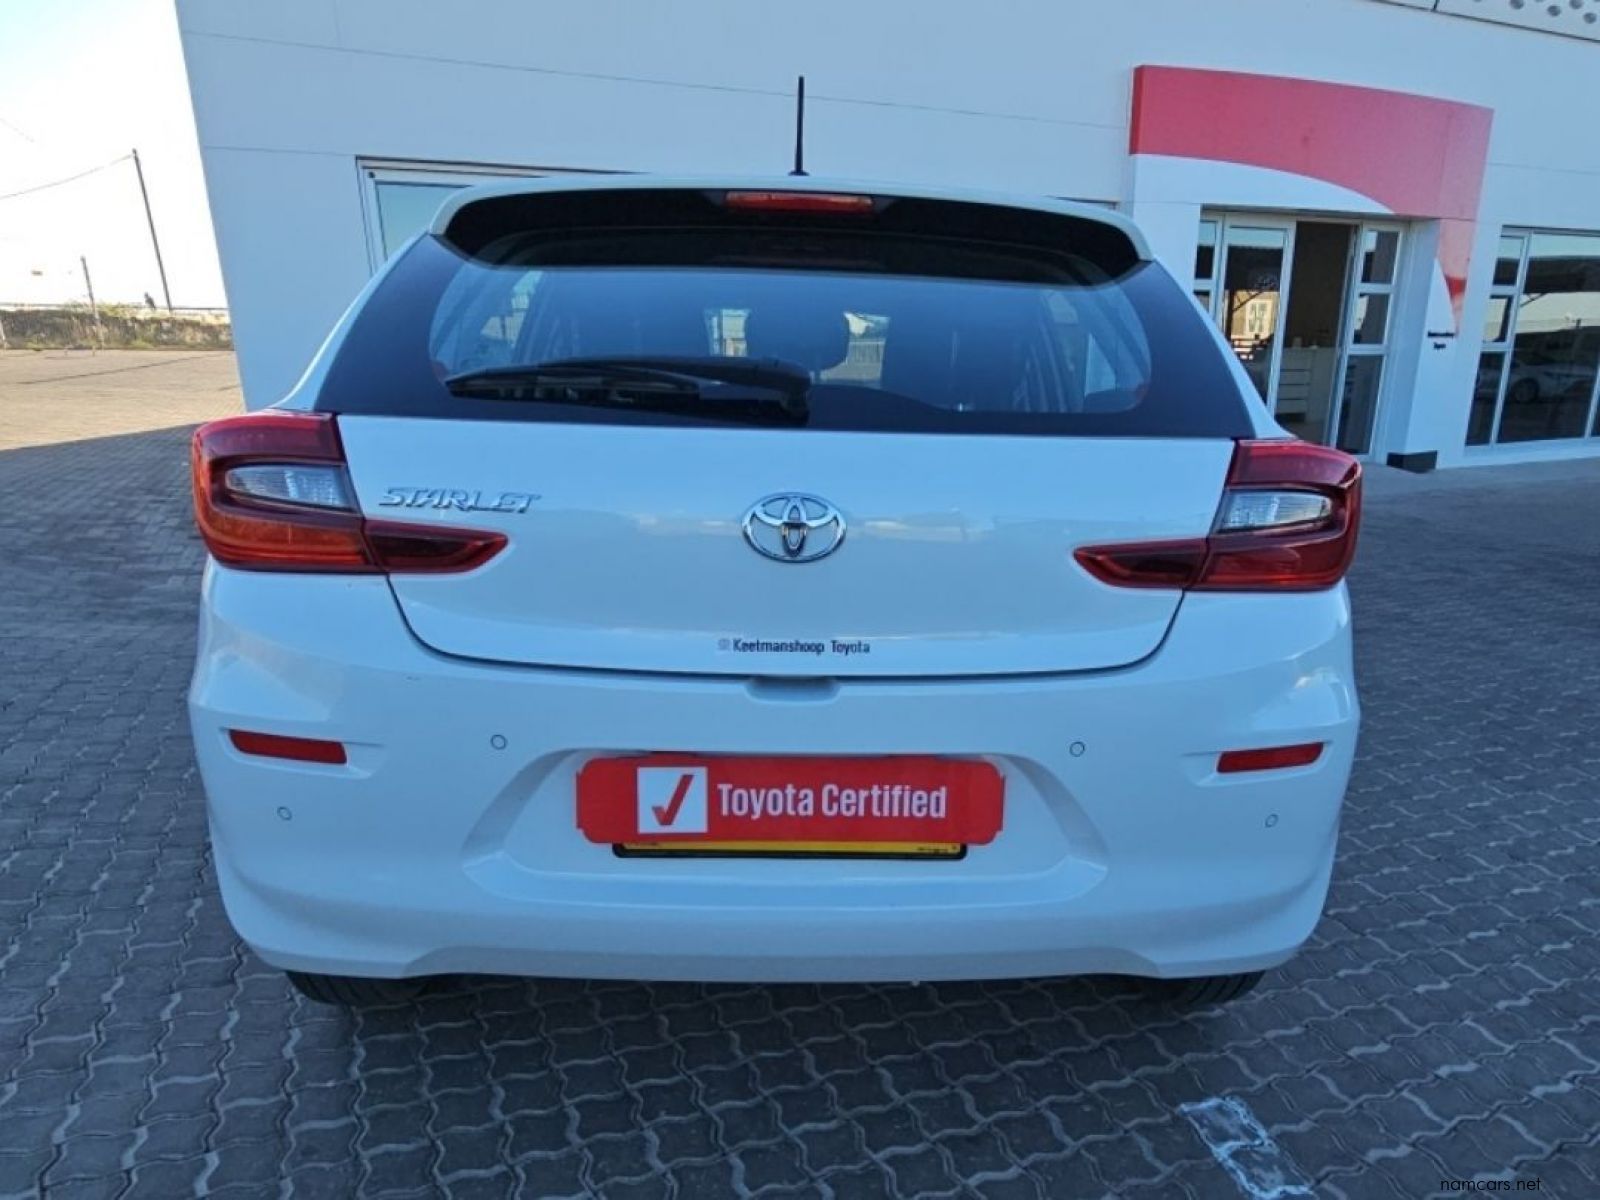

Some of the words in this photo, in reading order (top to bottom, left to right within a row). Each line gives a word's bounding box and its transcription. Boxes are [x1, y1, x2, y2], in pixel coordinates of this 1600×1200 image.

[379, 486, 541, 513] STARLET
[733, 638, 825, 655] Keetmanshoop
[830, 639, 871, 655] Toyota
[717, 783, 815, 820] Toyota
[822, 784, 947, 819] Certified
